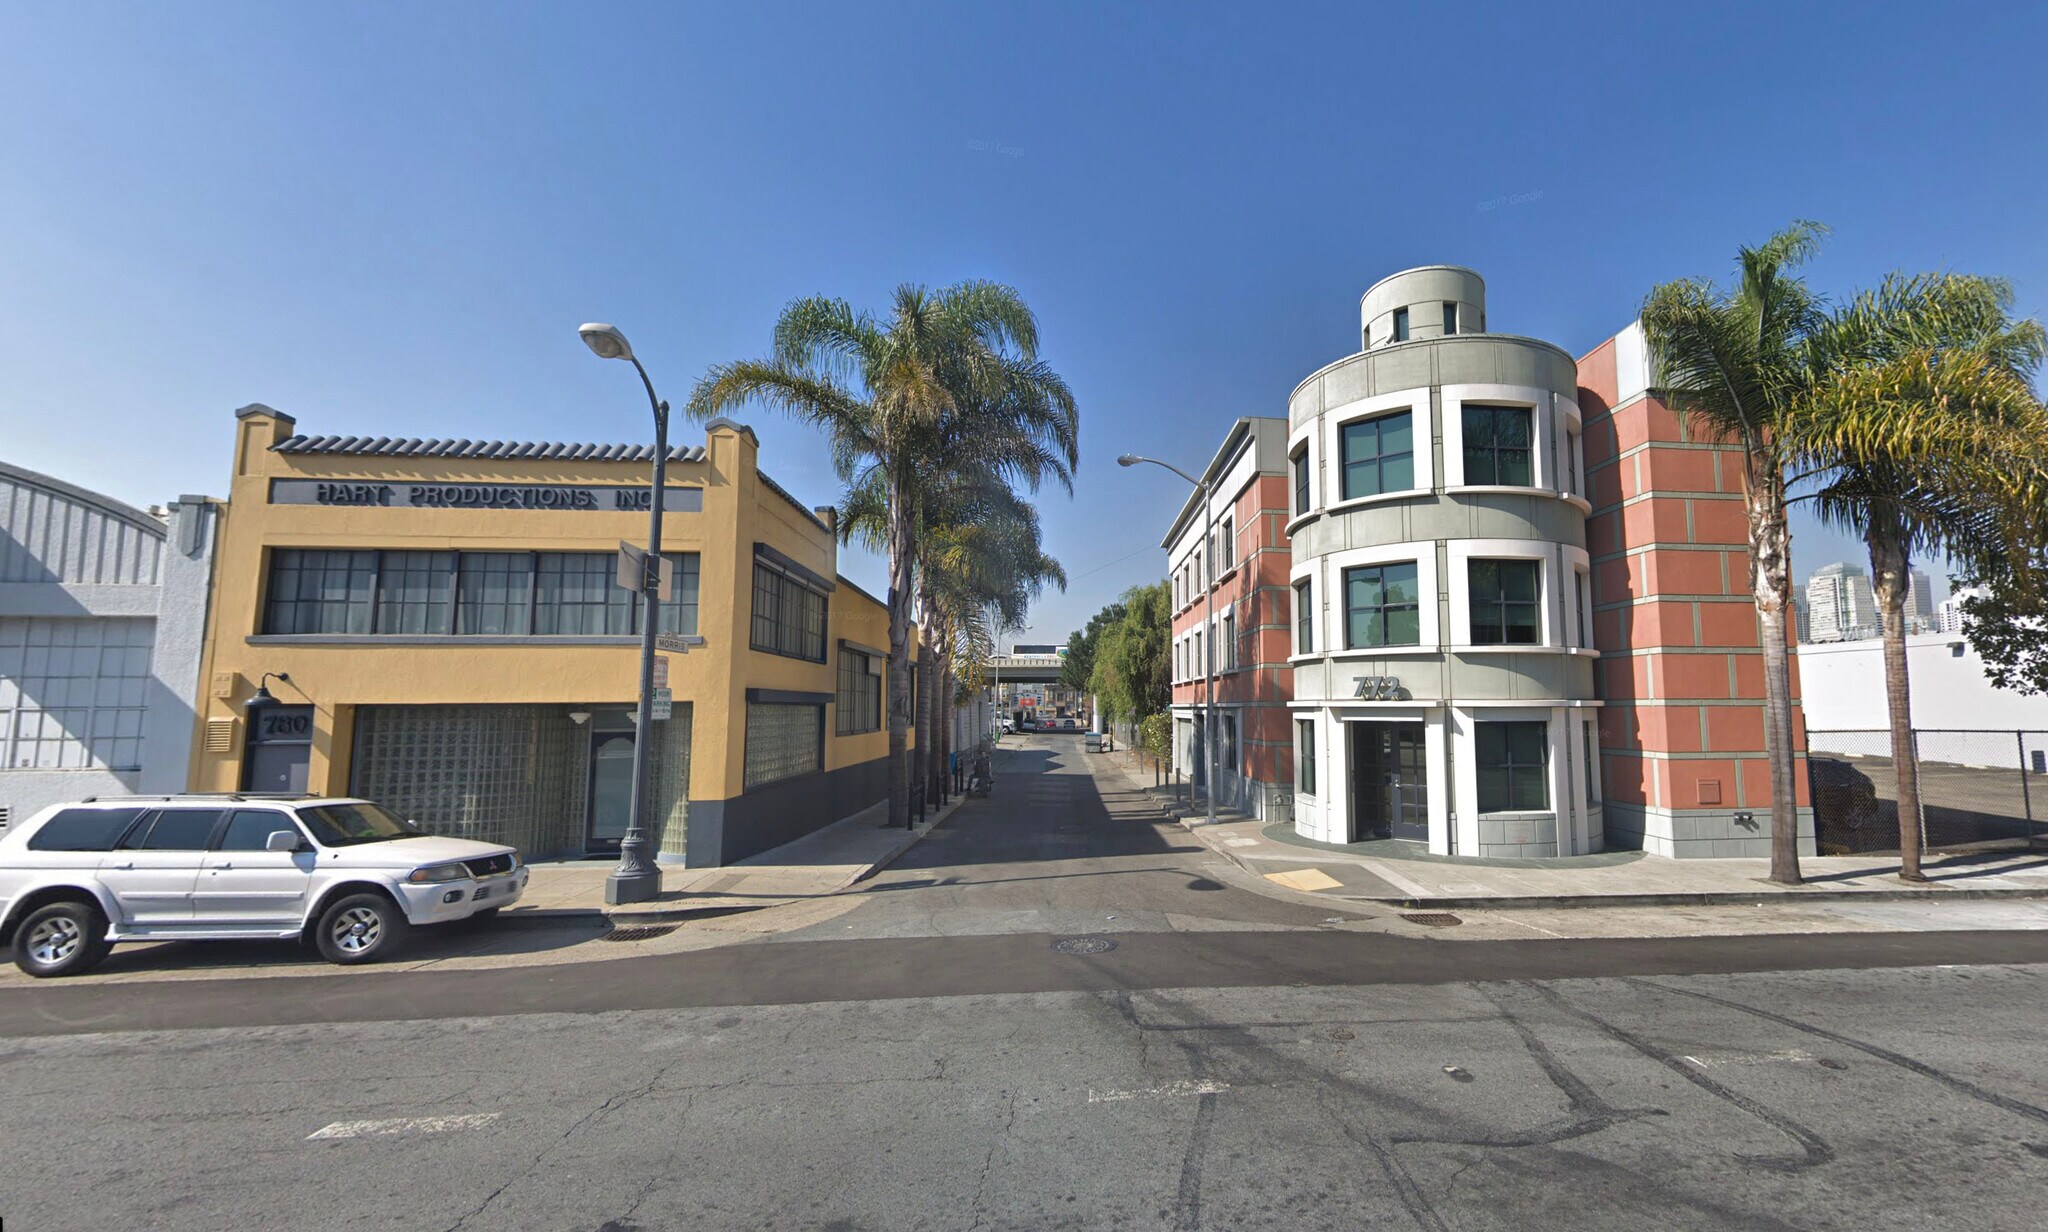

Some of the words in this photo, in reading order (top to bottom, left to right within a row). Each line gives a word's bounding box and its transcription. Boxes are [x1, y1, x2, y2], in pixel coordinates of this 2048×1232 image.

[316, 483, 387, 503] HART
[409, 485, 592, 507] PRODUCTIONS
[658, 638, 686, 651] MORRIS
[1353, 675, 1400, 700] 772
[263, 715, 309, 735] 780
